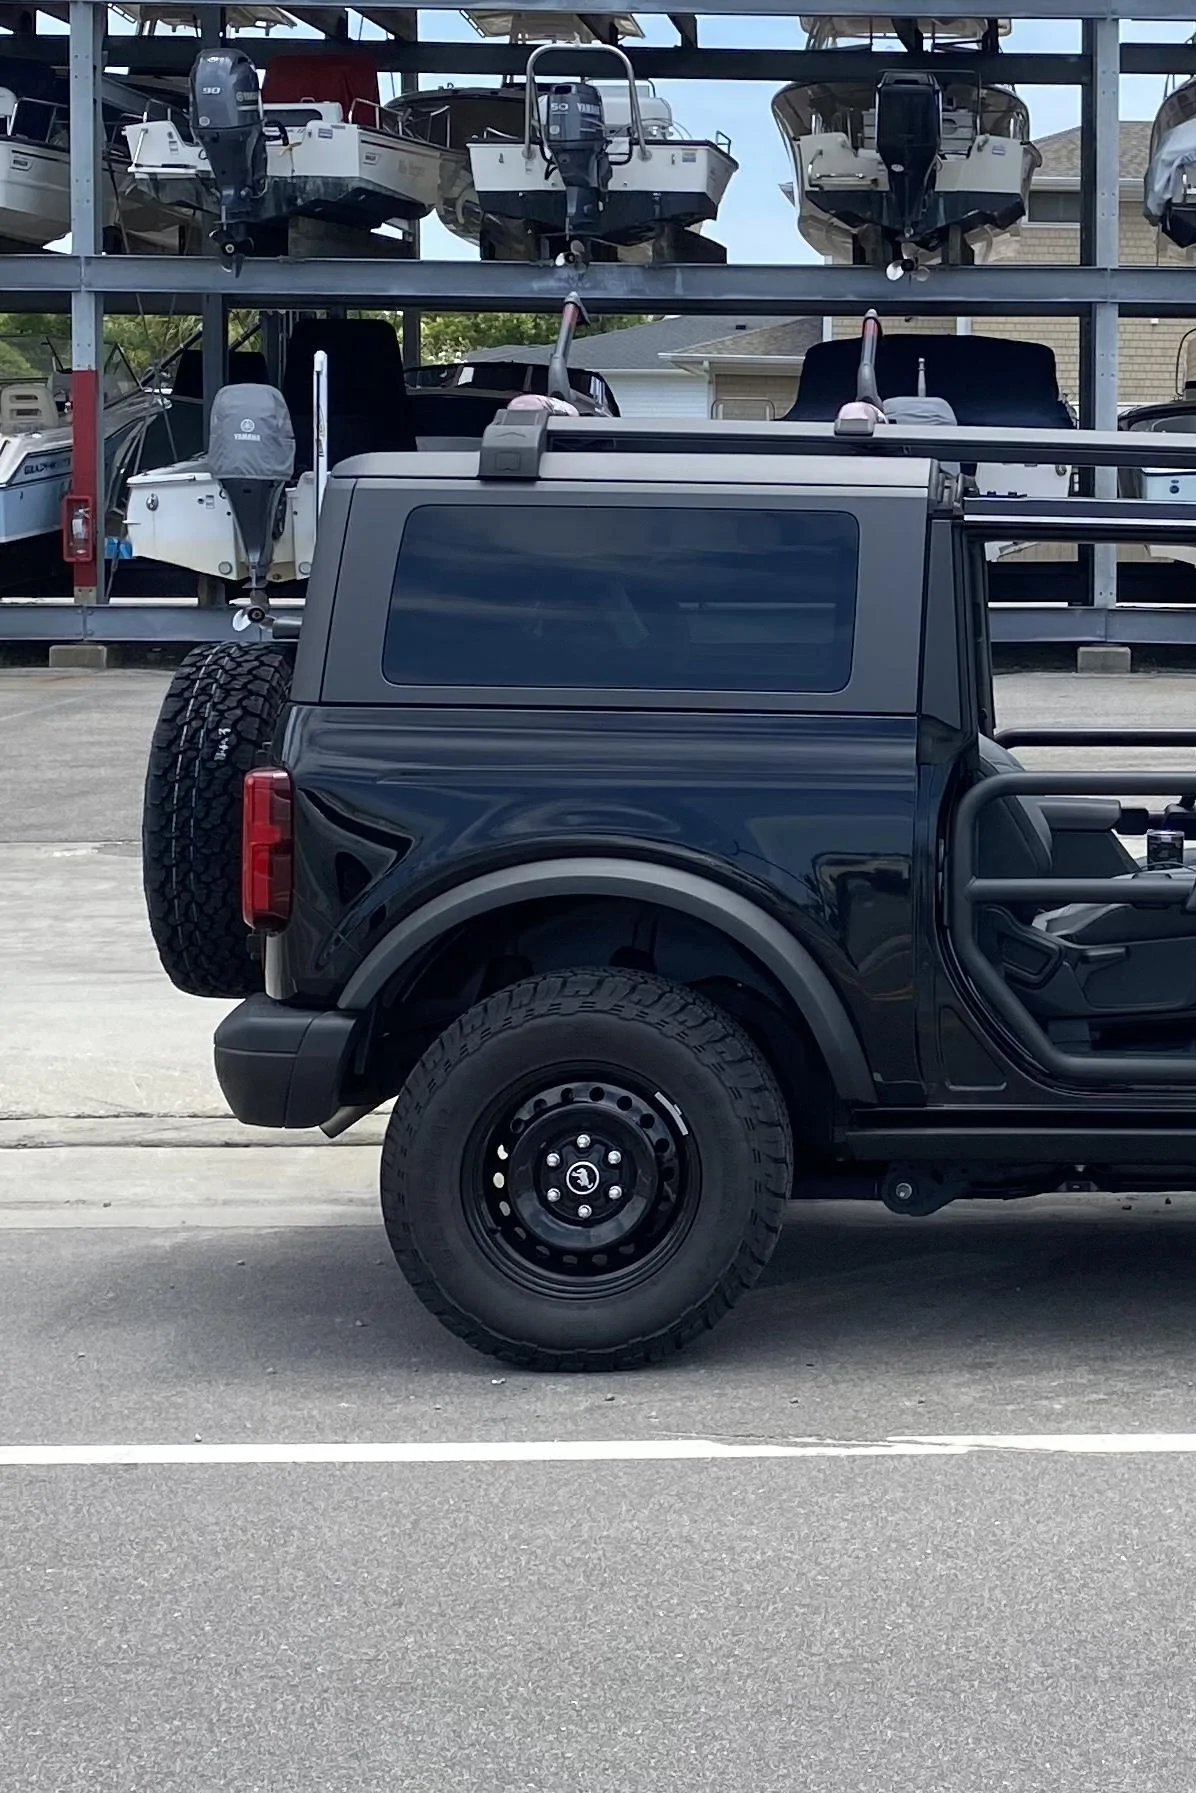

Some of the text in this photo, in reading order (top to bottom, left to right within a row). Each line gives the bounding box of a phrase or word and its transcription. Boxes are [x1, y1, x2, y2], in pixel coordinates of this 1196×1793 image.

[202, 86, 221, 95] 90
[550, 102, 569, 111] 50
[233, 433, 261, 441] YAMAHA
